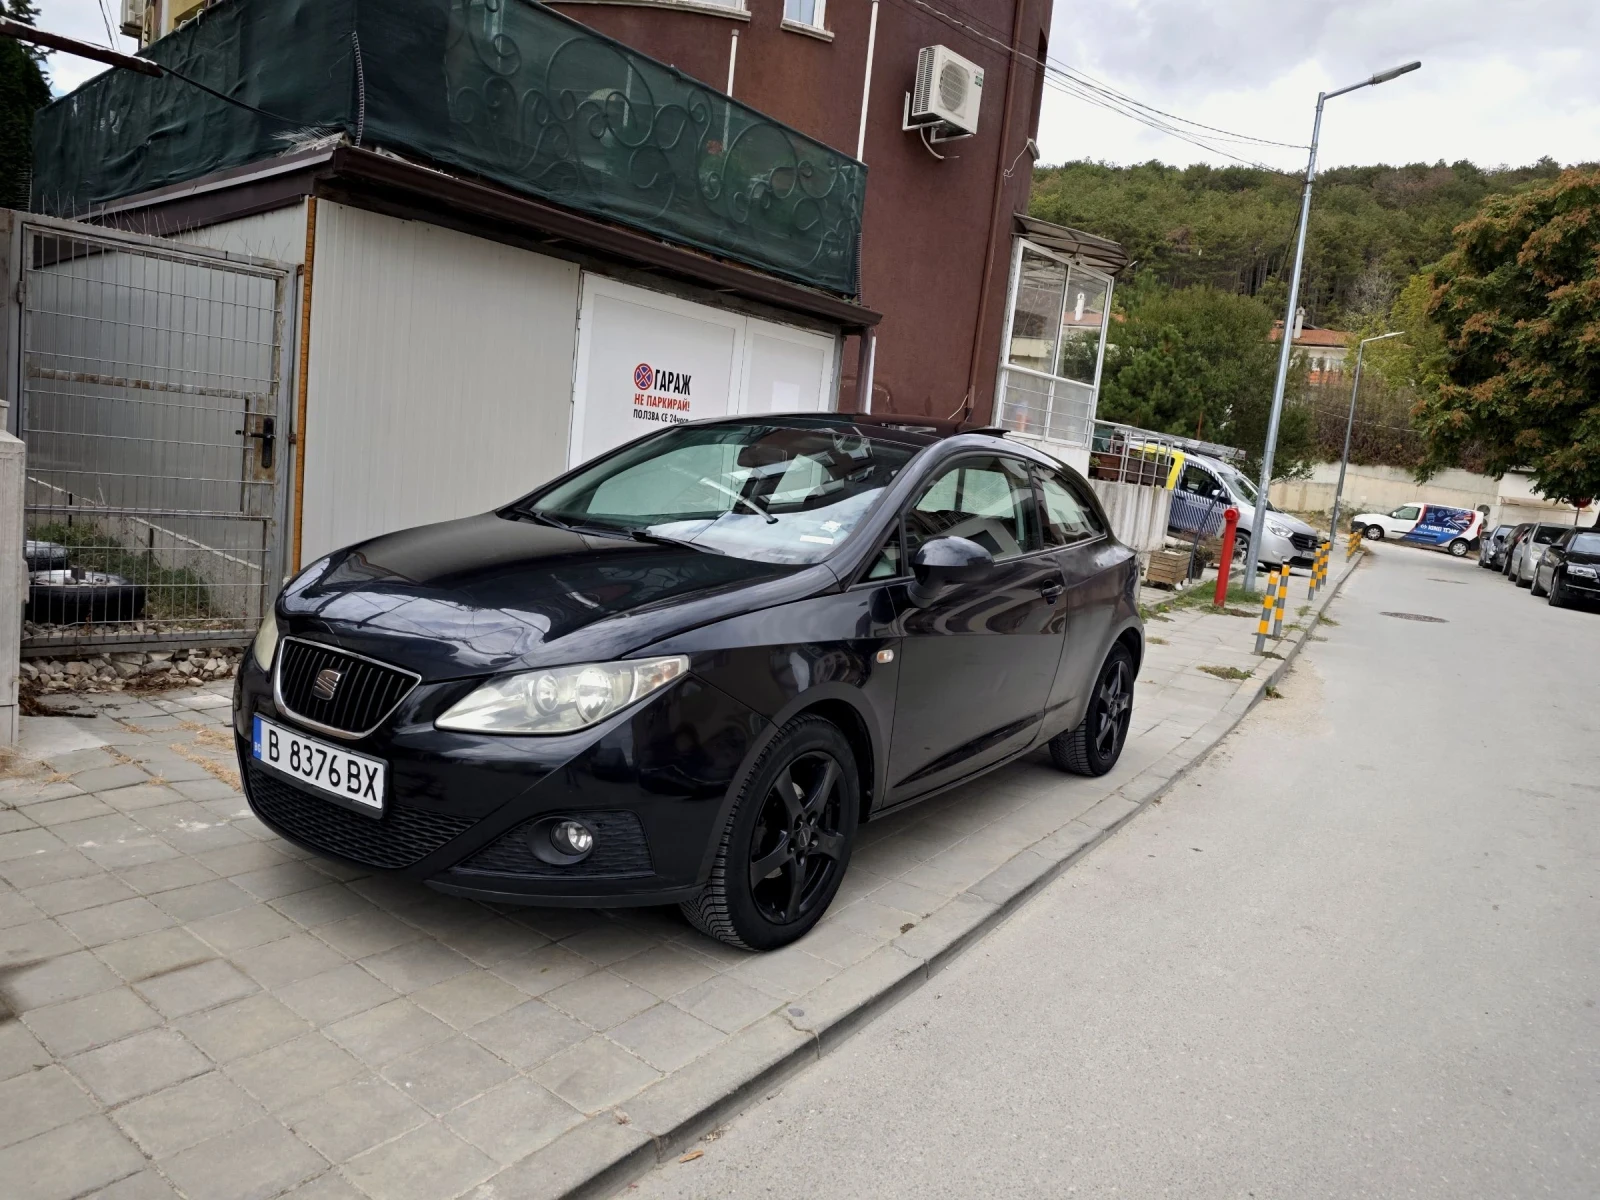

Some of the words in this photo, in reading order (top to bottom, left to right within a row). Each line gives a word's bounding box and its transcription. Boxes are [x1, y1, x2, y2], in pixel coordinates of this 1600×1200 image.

[654, 369, 692, 395] ГАРАЖ
[634, 393, 645, 406] НЕ
[646, 395, 690, 412] ПАРКИРАЙ!
[633, 409, 659, 421] ПОЛЗВА
[661, 413, 668, 423] СЕ
[290, 740, 341, 787] 8376
